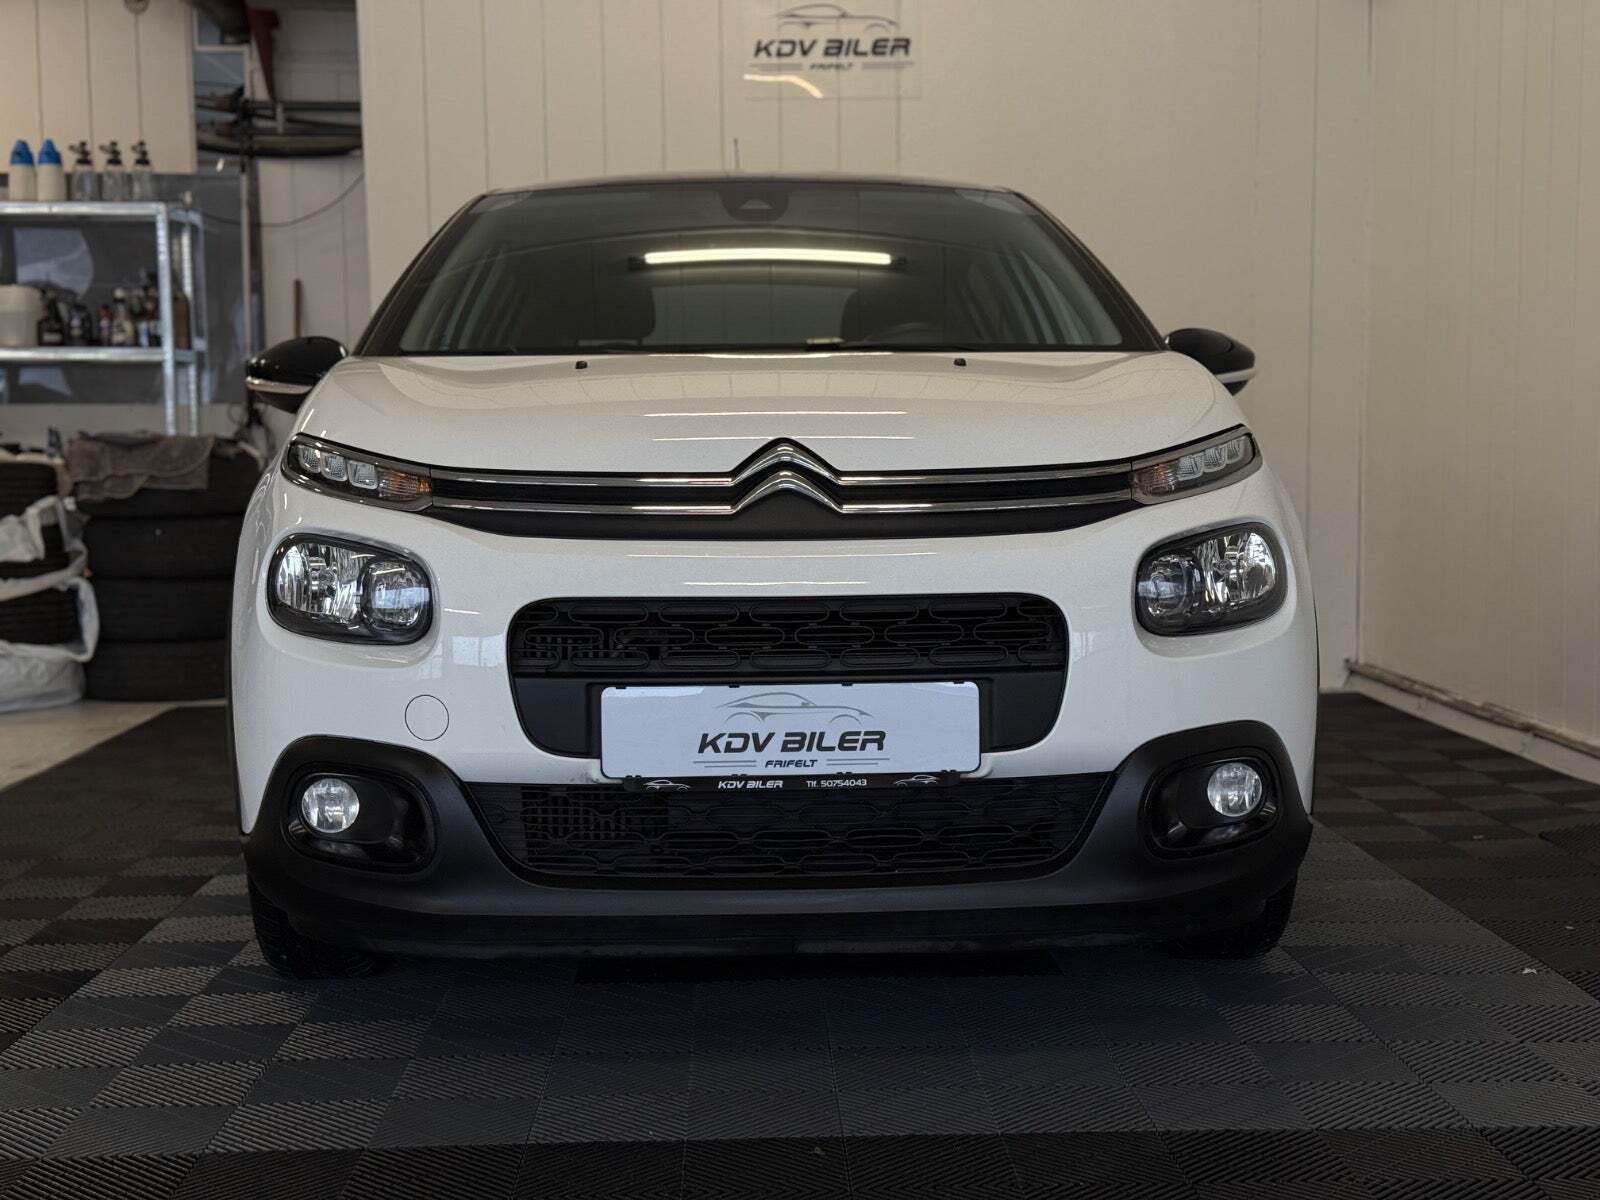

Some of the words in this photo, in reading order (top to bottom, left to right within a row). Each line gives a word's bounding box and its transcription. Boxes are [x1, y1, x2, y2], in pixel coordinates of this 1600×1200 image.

[753, 38, 818, 58] KDV
[822, 37, 912, 57] BILER
[697, 731, 776, 754] KDV
[780, 730, 887, 753] BILER
[764, 759, 818, 768] FRIFELT
[718, 780, 745, 789] KDV
[746, 780, 784, 789] BILER
[820, 778, 867, 788] 50754043
